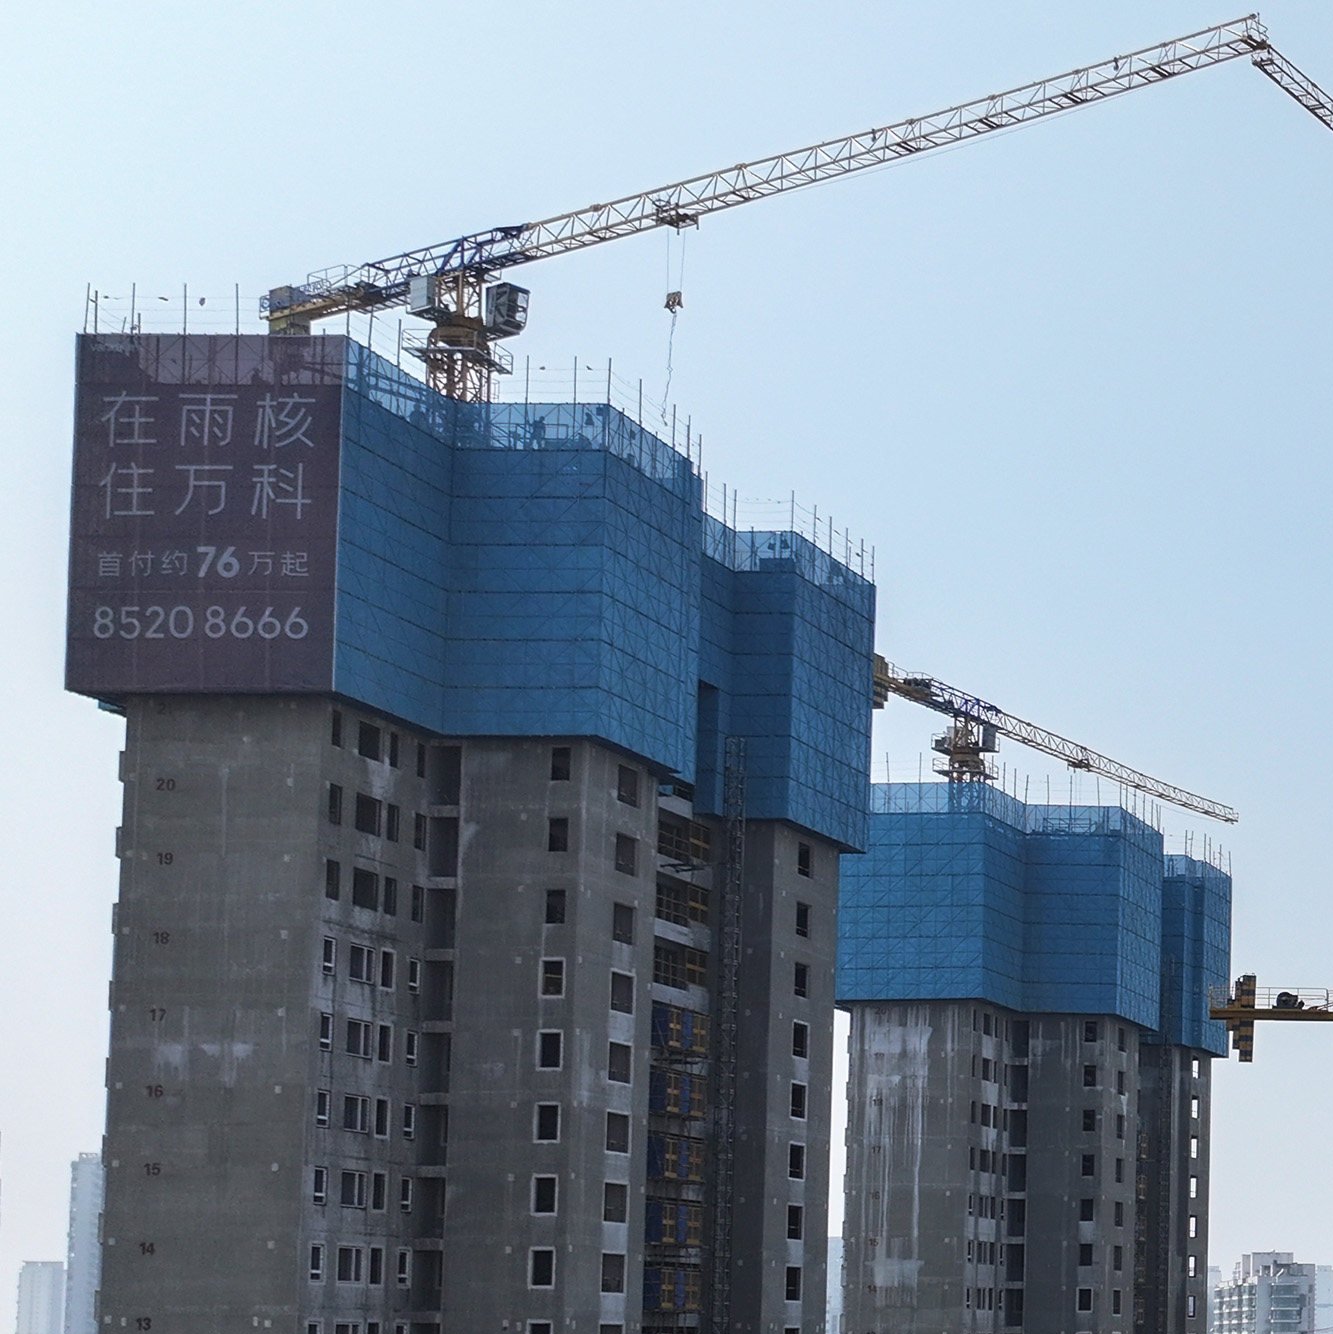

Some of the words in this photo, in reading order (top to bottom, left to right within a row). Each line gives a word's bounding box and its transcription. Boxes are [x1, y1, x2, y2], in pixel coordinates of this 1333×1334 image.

[101, 391, 316, 449] 在雨核
[100, 462, 312, 520] 住万科
[98, 546, 310, 578] 首付约76万起
[156, 779, 176, 792] 20
[157, 852, 174, 866] 19
[153, 933, 171, 945] 18
[149, 1009, 167, 1022] 17
[147, 1085, 164, 1098] 16
[144, 1163, 161, 1177] 15
[139, 1243, 156, 1256] 14
[136, 1318, 153, 1331] 13
